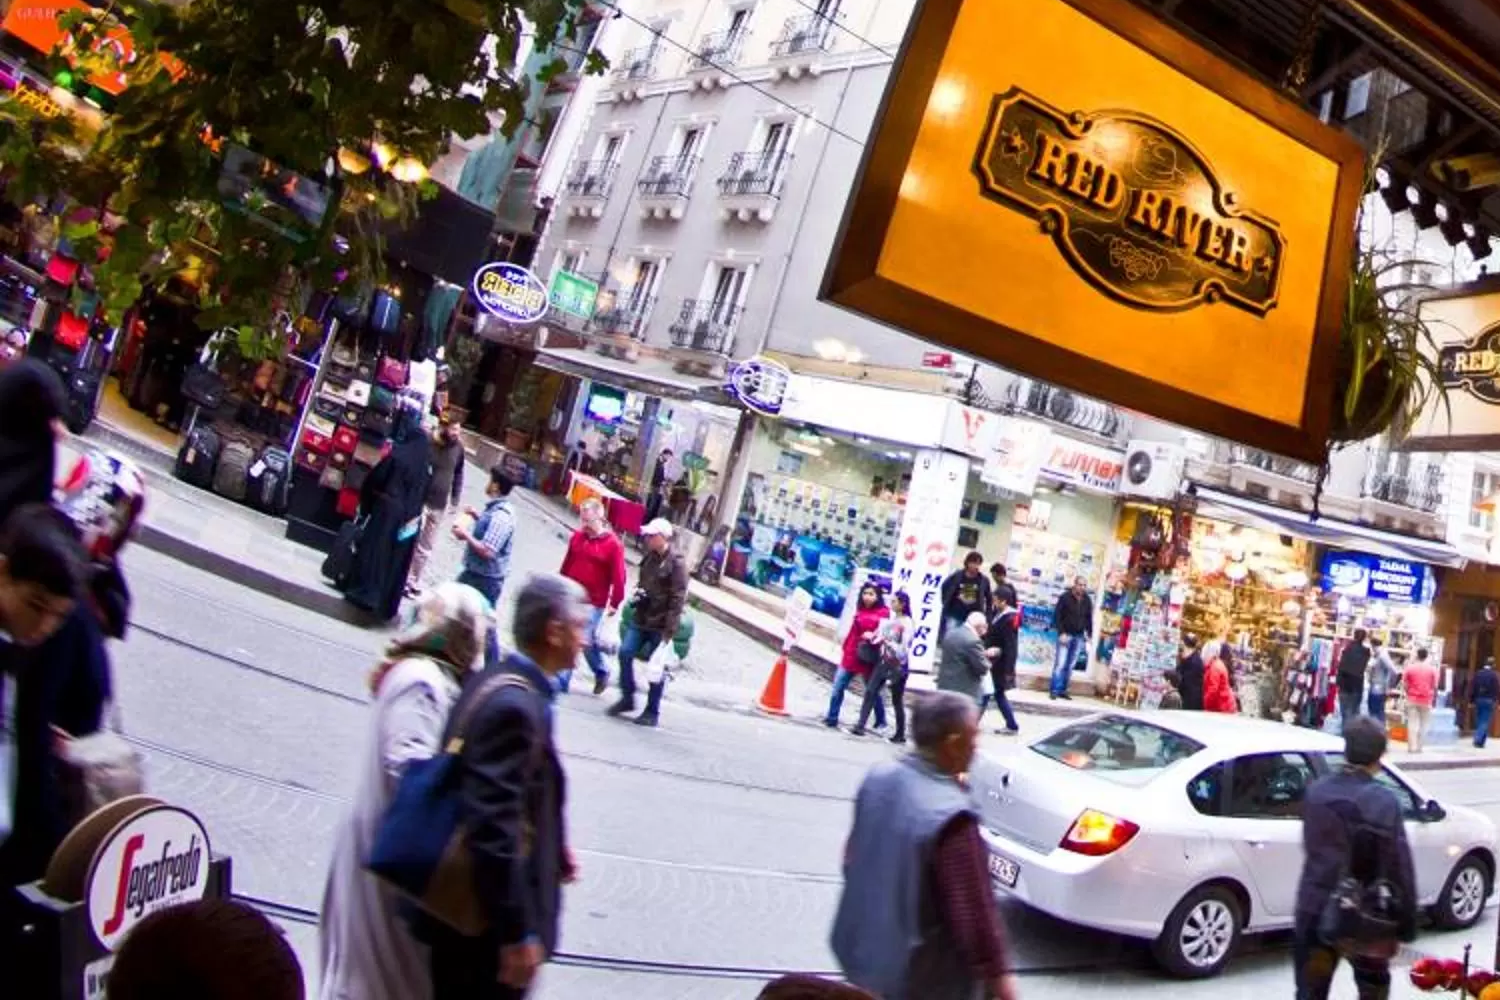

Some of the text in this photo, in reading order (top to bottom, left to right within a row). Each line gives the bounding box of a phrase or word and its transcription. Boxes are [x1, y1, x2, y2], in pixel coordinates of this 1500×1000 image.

[1028, 131, 1251, 273] RED RIVER
[1454, 350, 1496, 372] RED
[1082, 472, 1117, 491] Travel
[912, 572, 942, 658] METRO
[103, 833, 201, 937] Segafredo
